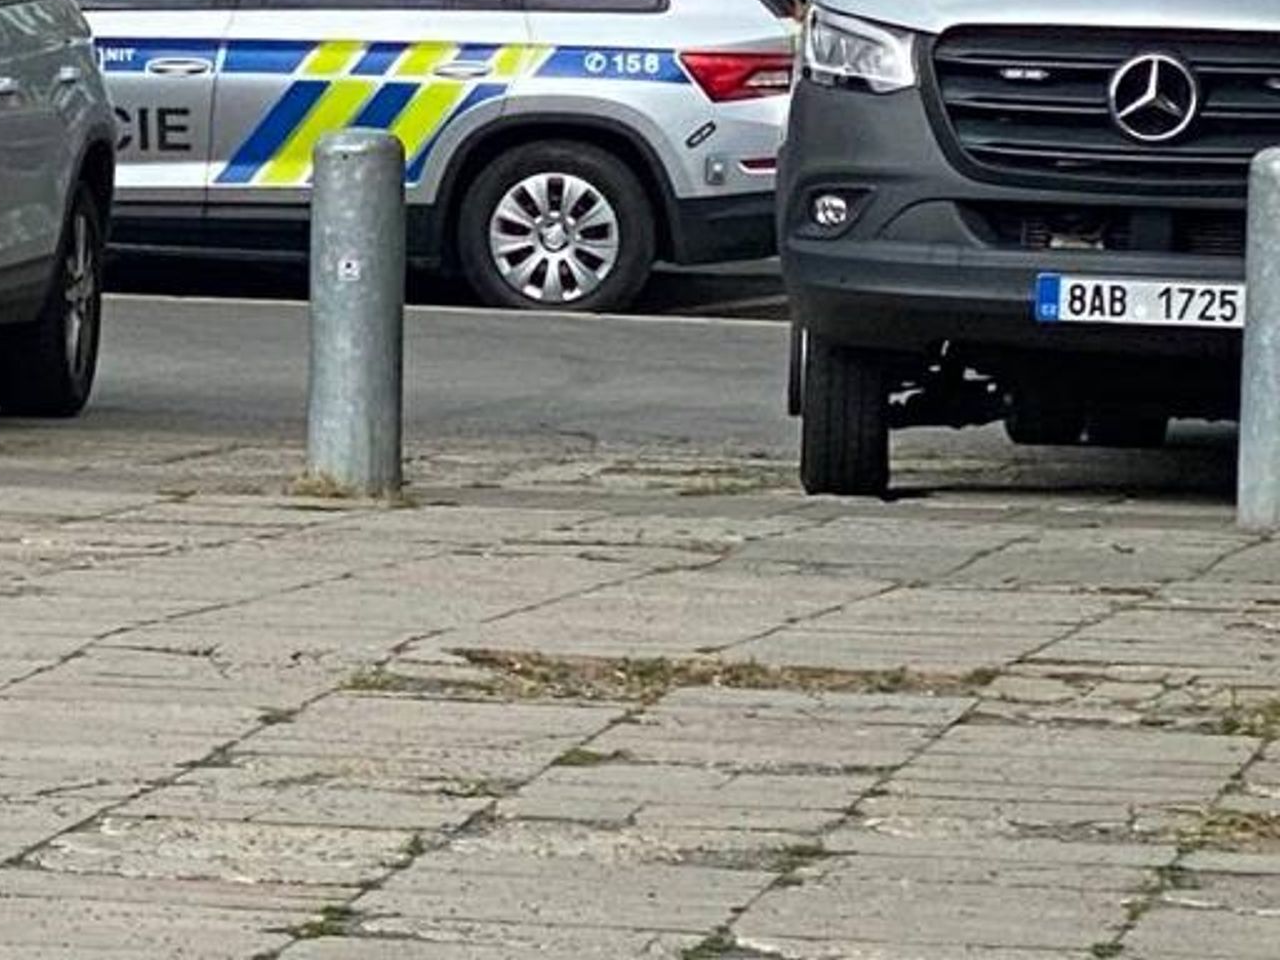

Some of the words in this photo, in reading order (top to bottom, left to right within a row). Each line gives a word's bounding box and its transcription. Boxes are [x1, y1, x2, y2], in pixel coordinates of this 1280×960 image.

[612, 52, 659, 74] 158
[1069, 284, 1127, 317] 8AB
[1158, 287, 1238, 322] 1725
